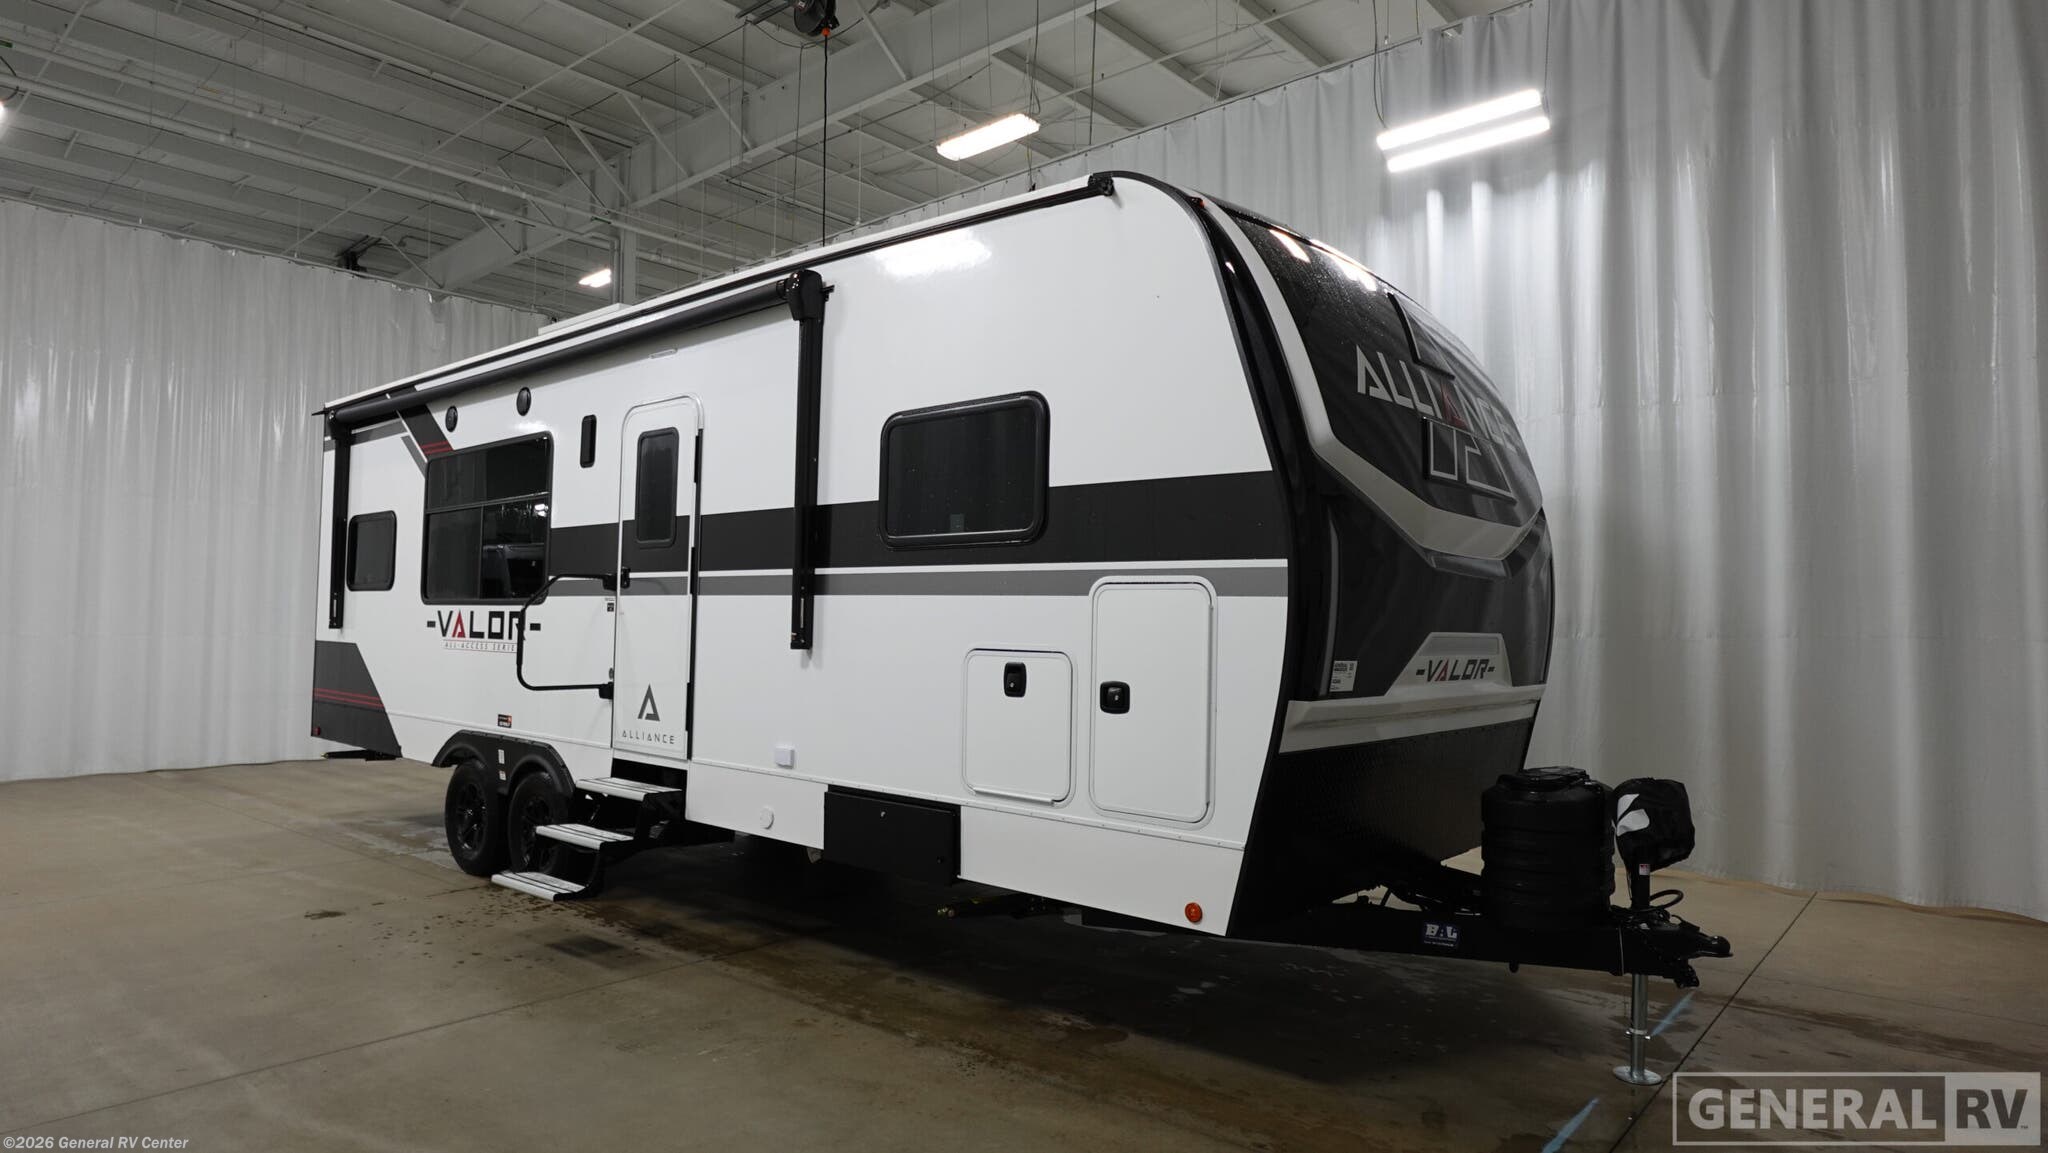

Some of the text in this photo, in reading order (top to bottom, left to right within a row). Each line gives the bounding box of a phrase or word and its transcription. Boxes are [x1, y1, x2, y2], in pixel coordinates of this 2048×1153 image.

[1356, 344, 1521, 453] ALLIANCE
[492, 643, 515, 652] SERIE
[622, 730, 675, 744] ALLIANCE
